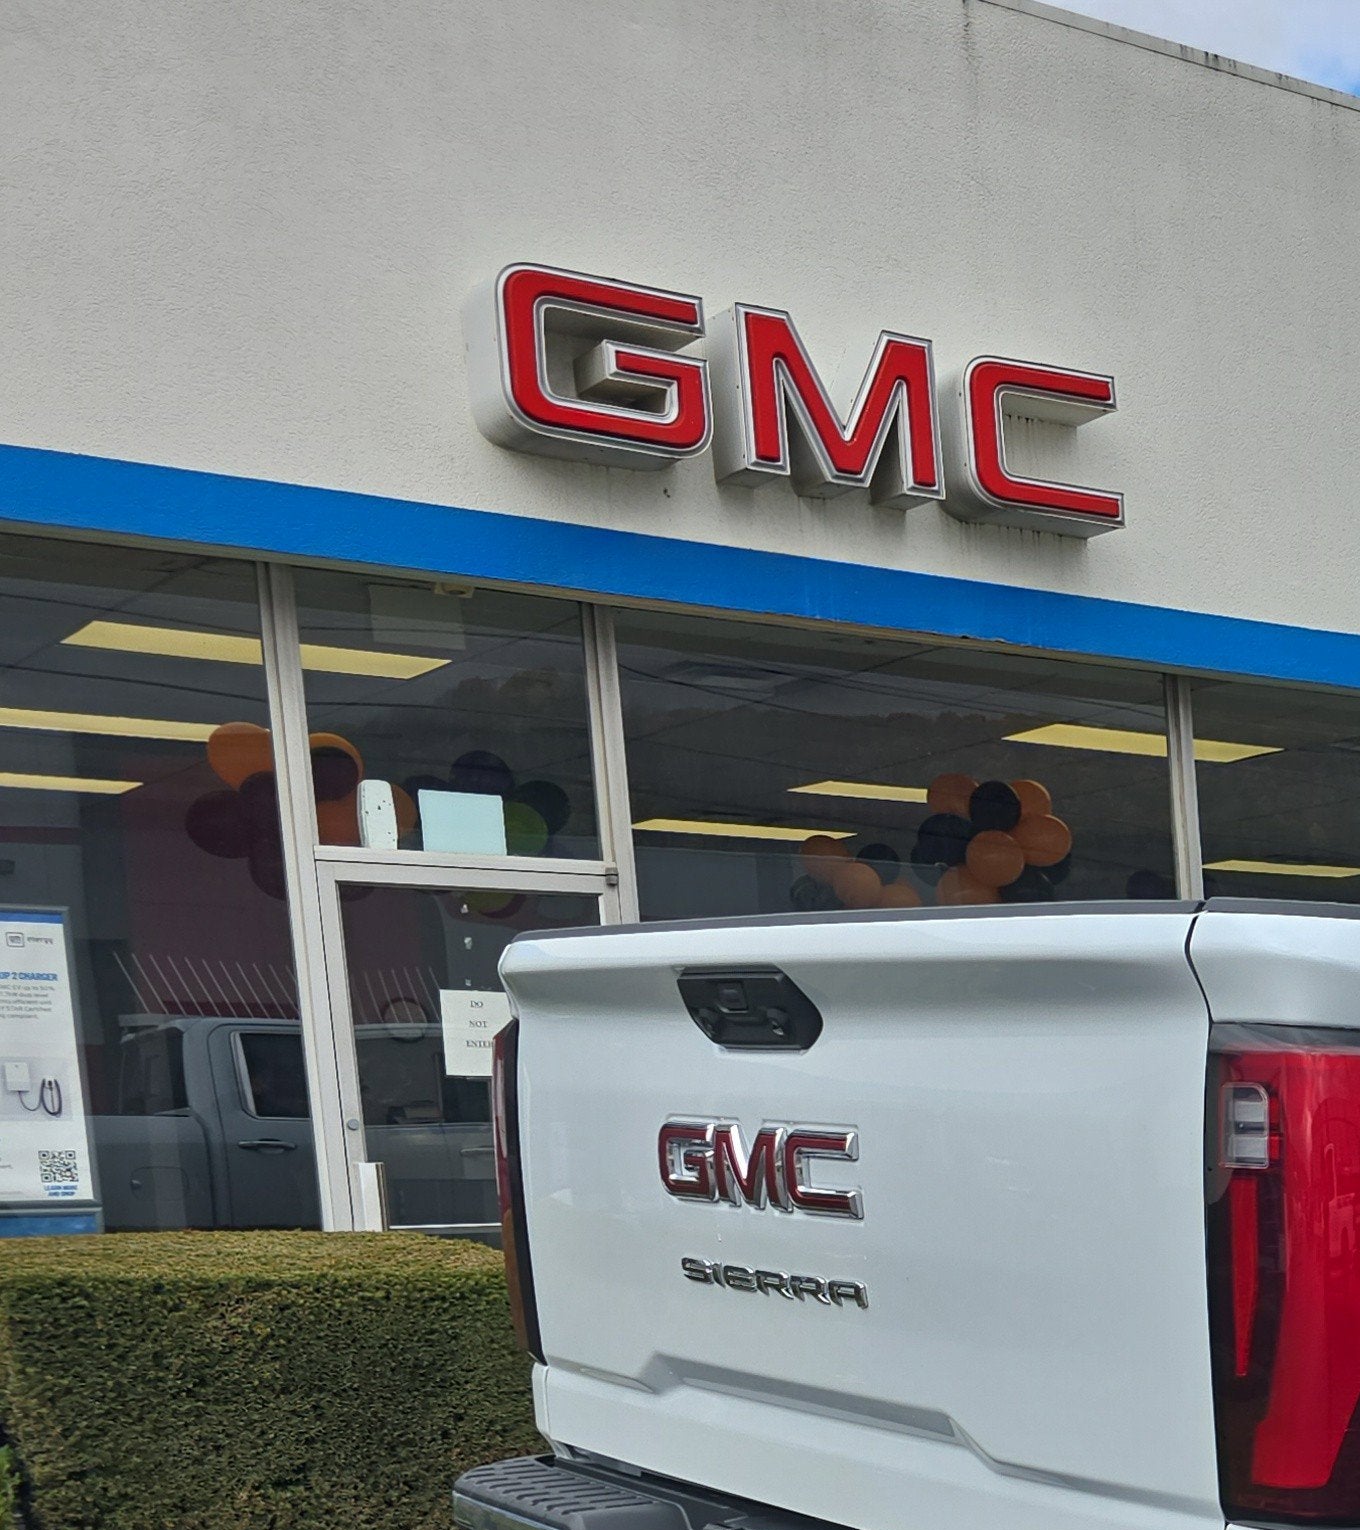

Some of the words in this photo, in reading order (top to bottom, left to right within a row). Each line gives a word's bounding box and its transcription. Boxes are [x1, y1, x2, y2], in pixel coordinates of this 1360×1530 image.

[495, 262, 1126, 530] GMC
[18, 972, 58, 981] CHARGER
[470, 1000, 483, 1008] DO
[469, 1020, 488, 1028] NOT
[658, 1114, 865, 1221] GMC
[681, 1256, 869, 1309] SIERRA
